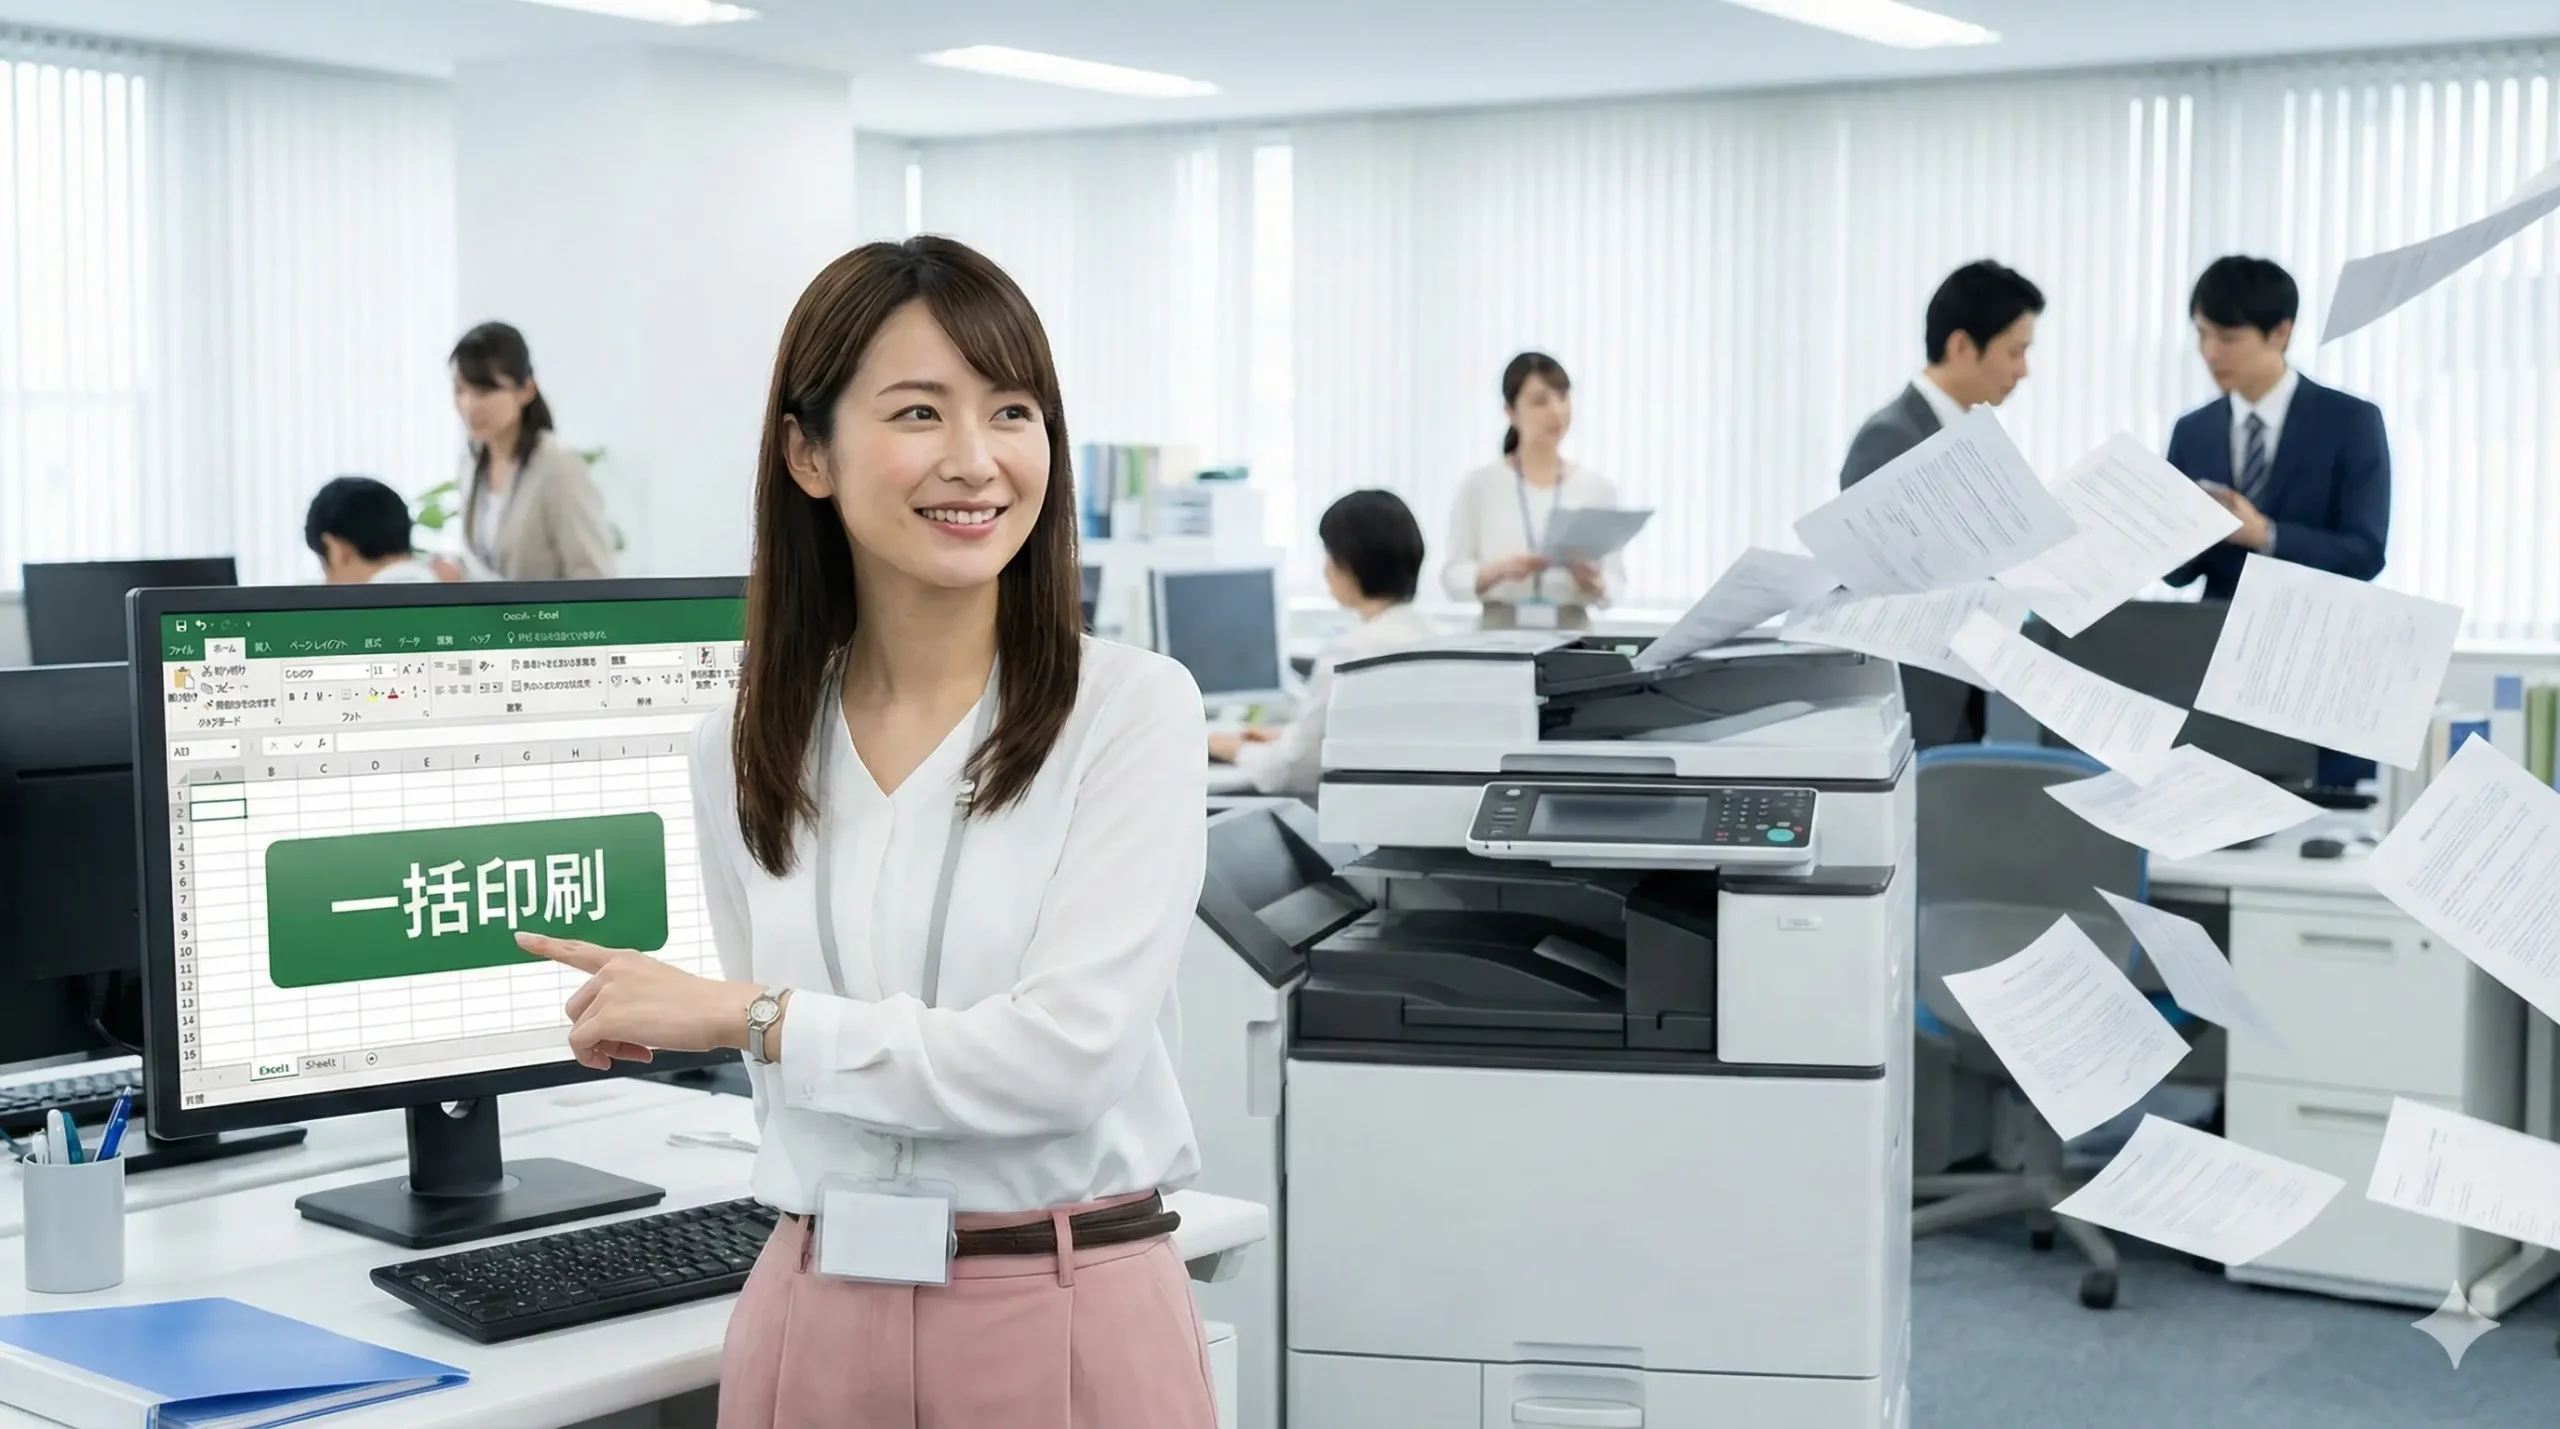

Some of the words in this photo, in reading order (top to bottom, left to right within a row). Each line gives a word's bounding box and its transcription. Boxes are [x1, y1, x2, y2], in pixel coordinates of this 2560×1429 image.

[213, 770, 222, 780] A
[319, 763, 328, 774] C
[423, 757, 430, 768] E
[474, 754, 481, 764] F
[522, 750, 531, 761] G
[572, 748, 580, 758] H
[176, 791, 182, 800] 1
[176, 808, 184, 818] 2
[178, 860, 186, 870] 5
[179, 877, 187, 887] 6
[180, 894, 187, 904] 7
[331, 849, 607, 939] 一括印刷
[180, 912, 189, 922] 8
[180, 929, 189, 940] 9
[180, 946, 193, 957] 10
[180, 964, 192, 974] 11
[181, 981, 193, 991] 12
[183, 1033, 196, 1043] 15
